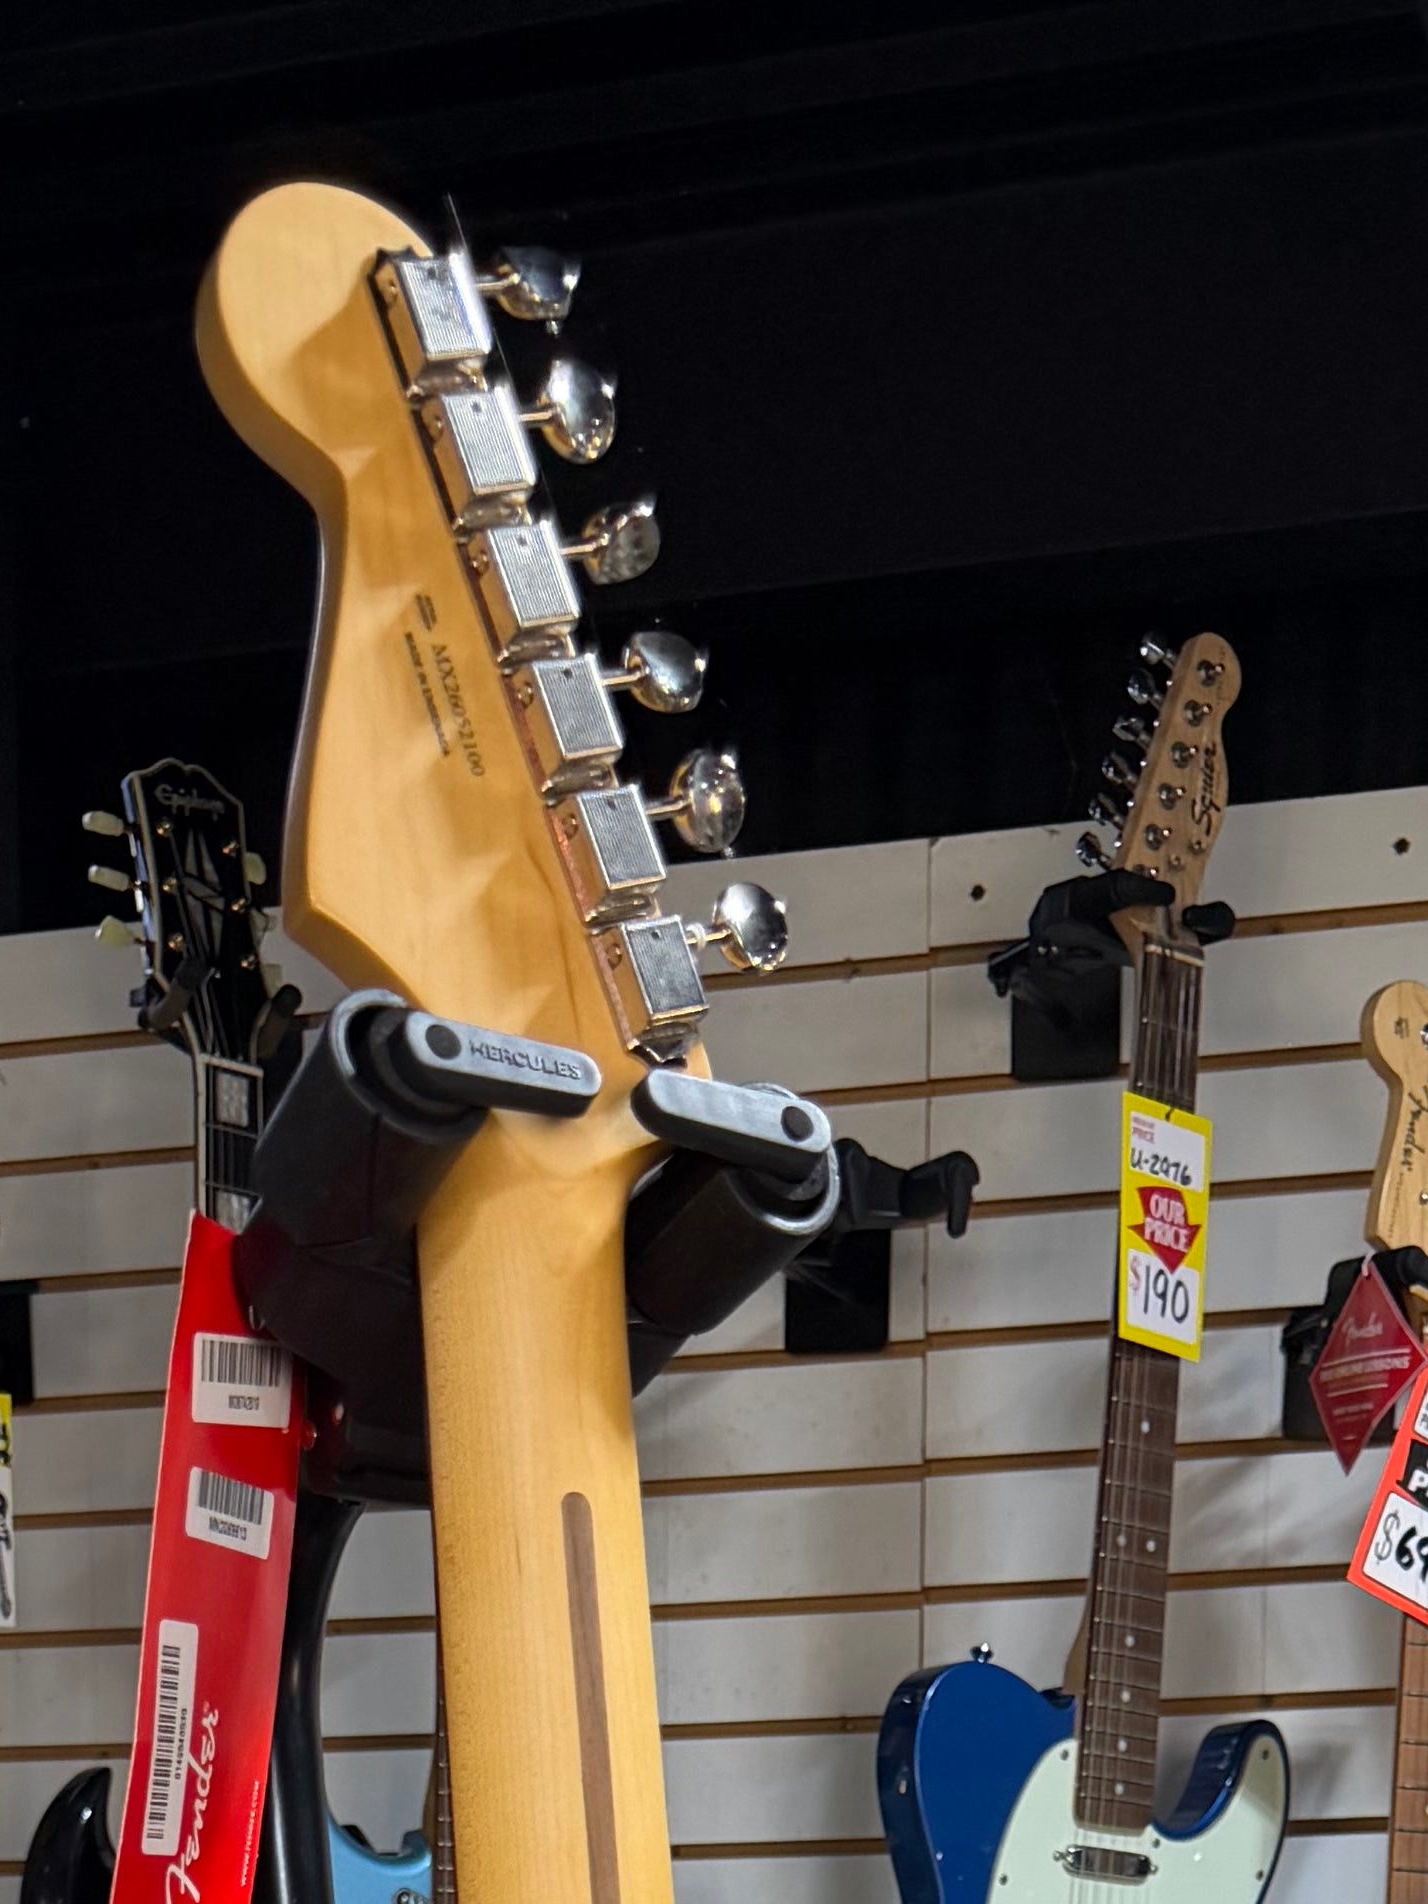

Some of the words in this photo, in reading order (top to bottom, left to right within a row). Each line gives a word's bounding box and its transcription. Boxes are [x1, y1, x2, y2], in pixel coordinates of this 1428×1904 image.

[468, 1040, 582, 1080] HERCULES
[1149, 1194, 1185, 1226] OUR
[1144, 1217, 1190, 1253] PRICE
[1129, 1255, 1190, 1324] $190
